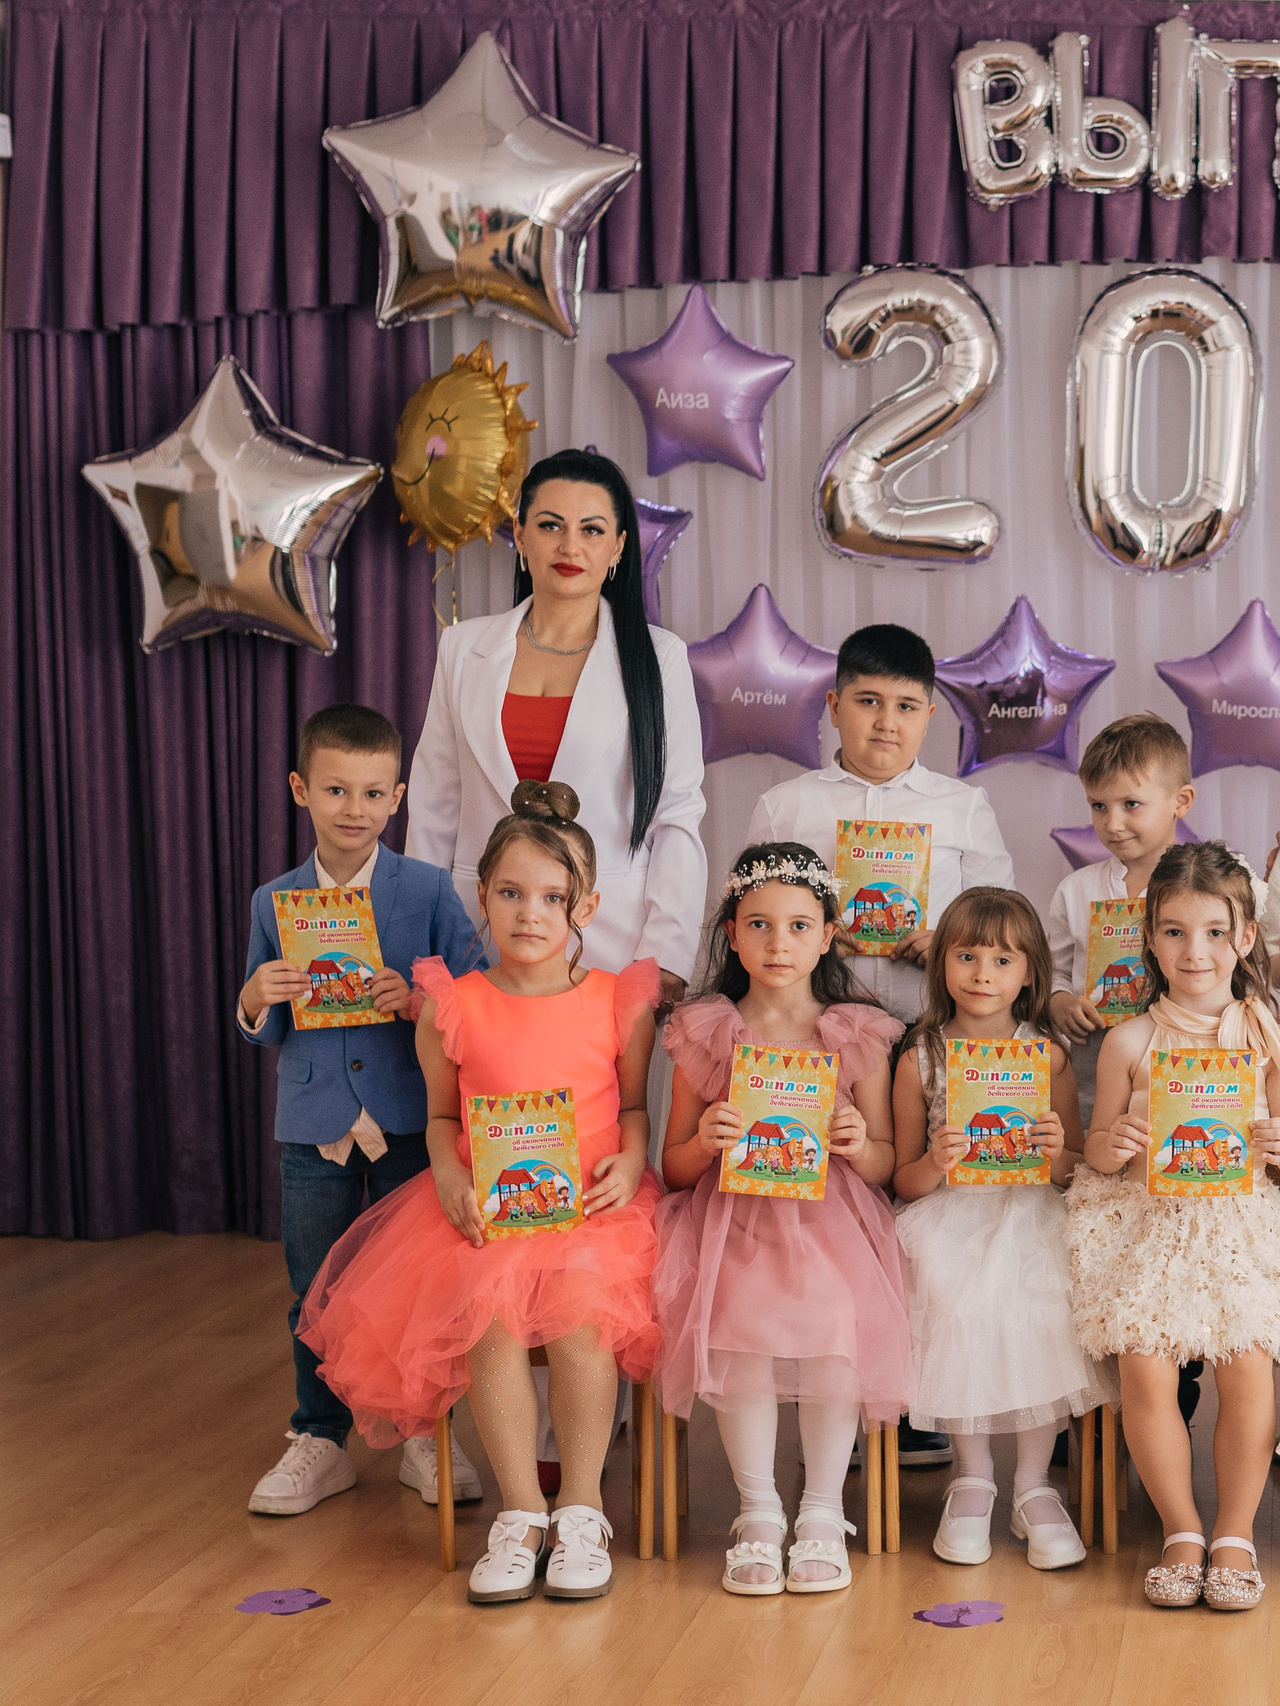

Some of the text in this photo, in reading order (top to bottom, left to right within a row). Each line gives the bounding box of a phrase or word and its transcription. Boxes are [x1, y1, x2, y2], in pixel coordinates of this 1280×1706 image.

[655, 387, 710, 409] Аиза
[731, 686, 787, 707] Артём
[852, 847, 914, 860] Диплом
[294, 918, 358, 930] Диплом
[1102, 926, 1143, 936] Дипл
[966, 1069, 1032, 1081] Диплом
[750, 1075, 818, 1094] Диплом
[1169, 1081, 1238, 1094] Диплом
[770, 1100, 804, 1108] детского
[780, 1095, 819, 1103] окончании
[488, 1123, 558, 1138] Диплом
[522, 1136, 562, 1145] окончании
[512, 1144, 547, 1152] детского
